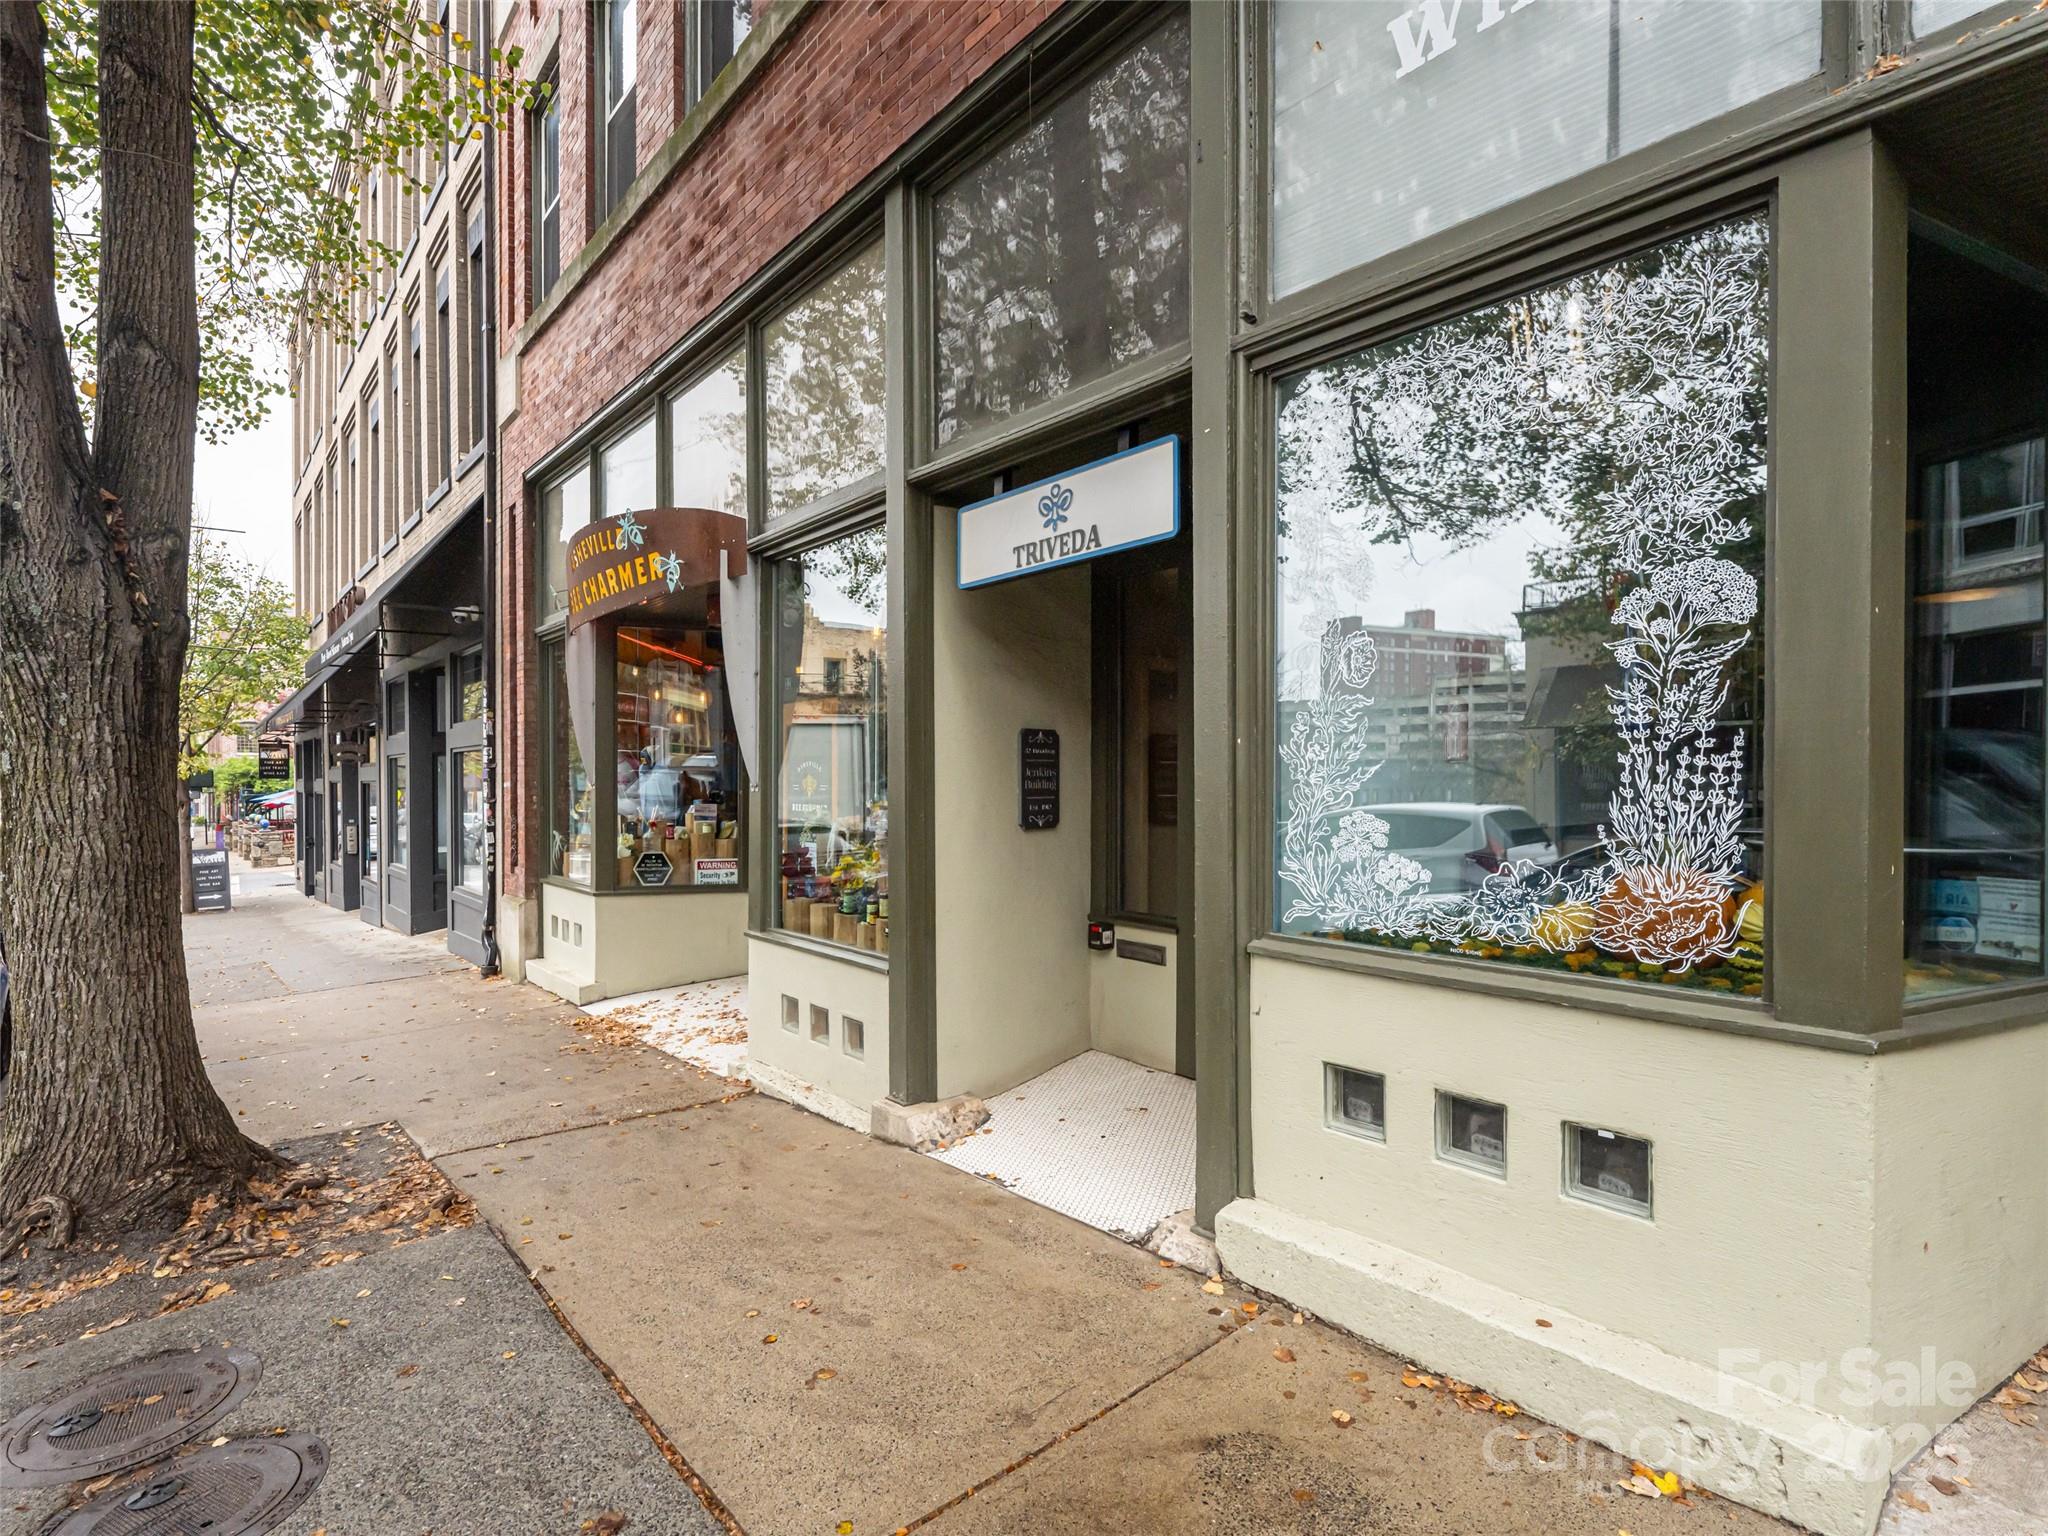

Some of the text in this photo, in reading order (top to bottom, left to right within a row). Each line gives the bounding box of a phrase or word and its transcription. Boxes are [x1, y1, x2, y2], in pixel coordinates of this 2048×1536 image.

[1013, 524, 1102, 568] TRIVEDA
[583, 551, 665, 606] CHARMER
[1025, 767, 1056, 778] Jenkins
[1024, 779, 1056, 790] Building
[700, 872, 720, 880] Security
